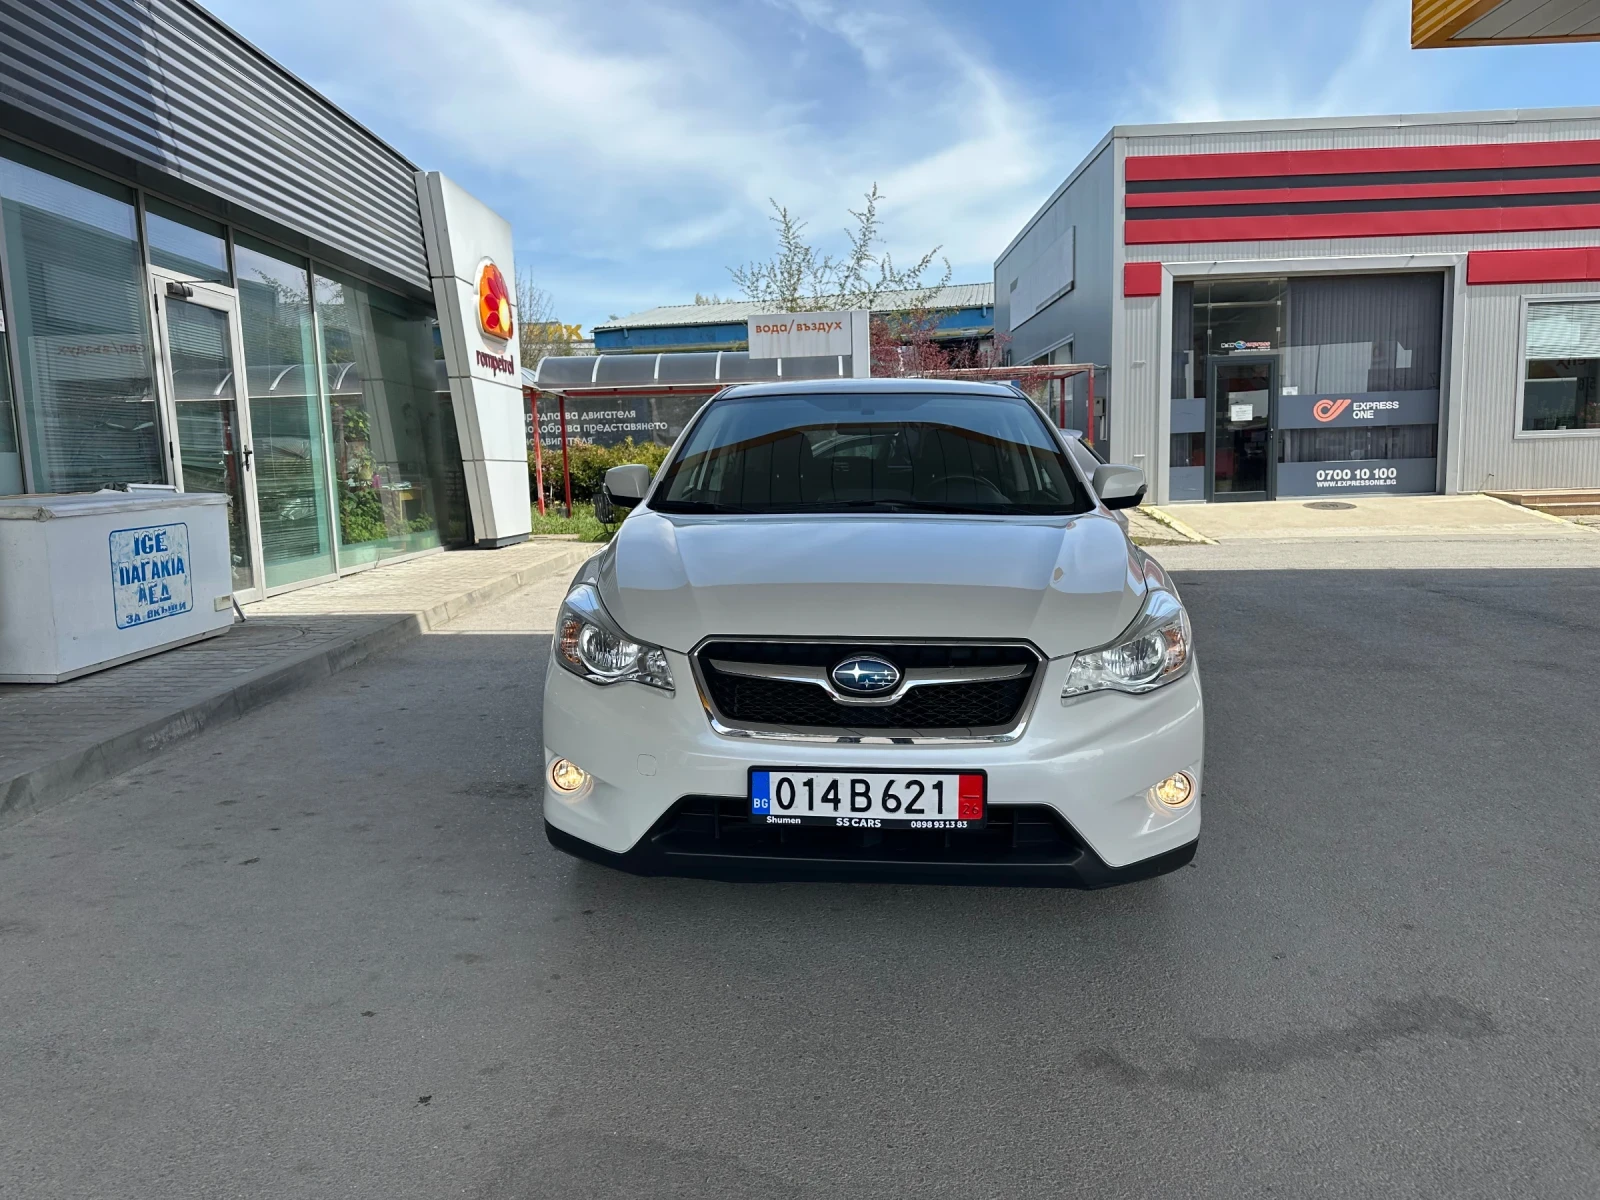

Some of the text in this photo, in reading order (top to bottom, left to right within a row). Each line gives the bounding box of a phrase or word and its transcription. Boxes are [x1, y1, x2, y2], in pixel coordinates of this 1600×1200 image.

[755, 319, 842, 334] вода/въздух
[476, 350, 514, 377] rompetrol
[1353, 401, 1399, 410] EXPRESS
[581, 410, 636, 420] двигателя
[1353, 410, 1374, 419] ONE
[583, 422, 668, 434] представянето
[1316, 467, 1397, 480] 0700 10 100
[1316, 479, 1397, 487] WWW.EXPRESSONE.BG
[133, 528, 168, 556] ICE
[125, 613, 141, 624] ЗА
[753, 798, 769, 808] BG
[766, 815, 968, 829] Shumen SS CARS 0898 93 13 83
